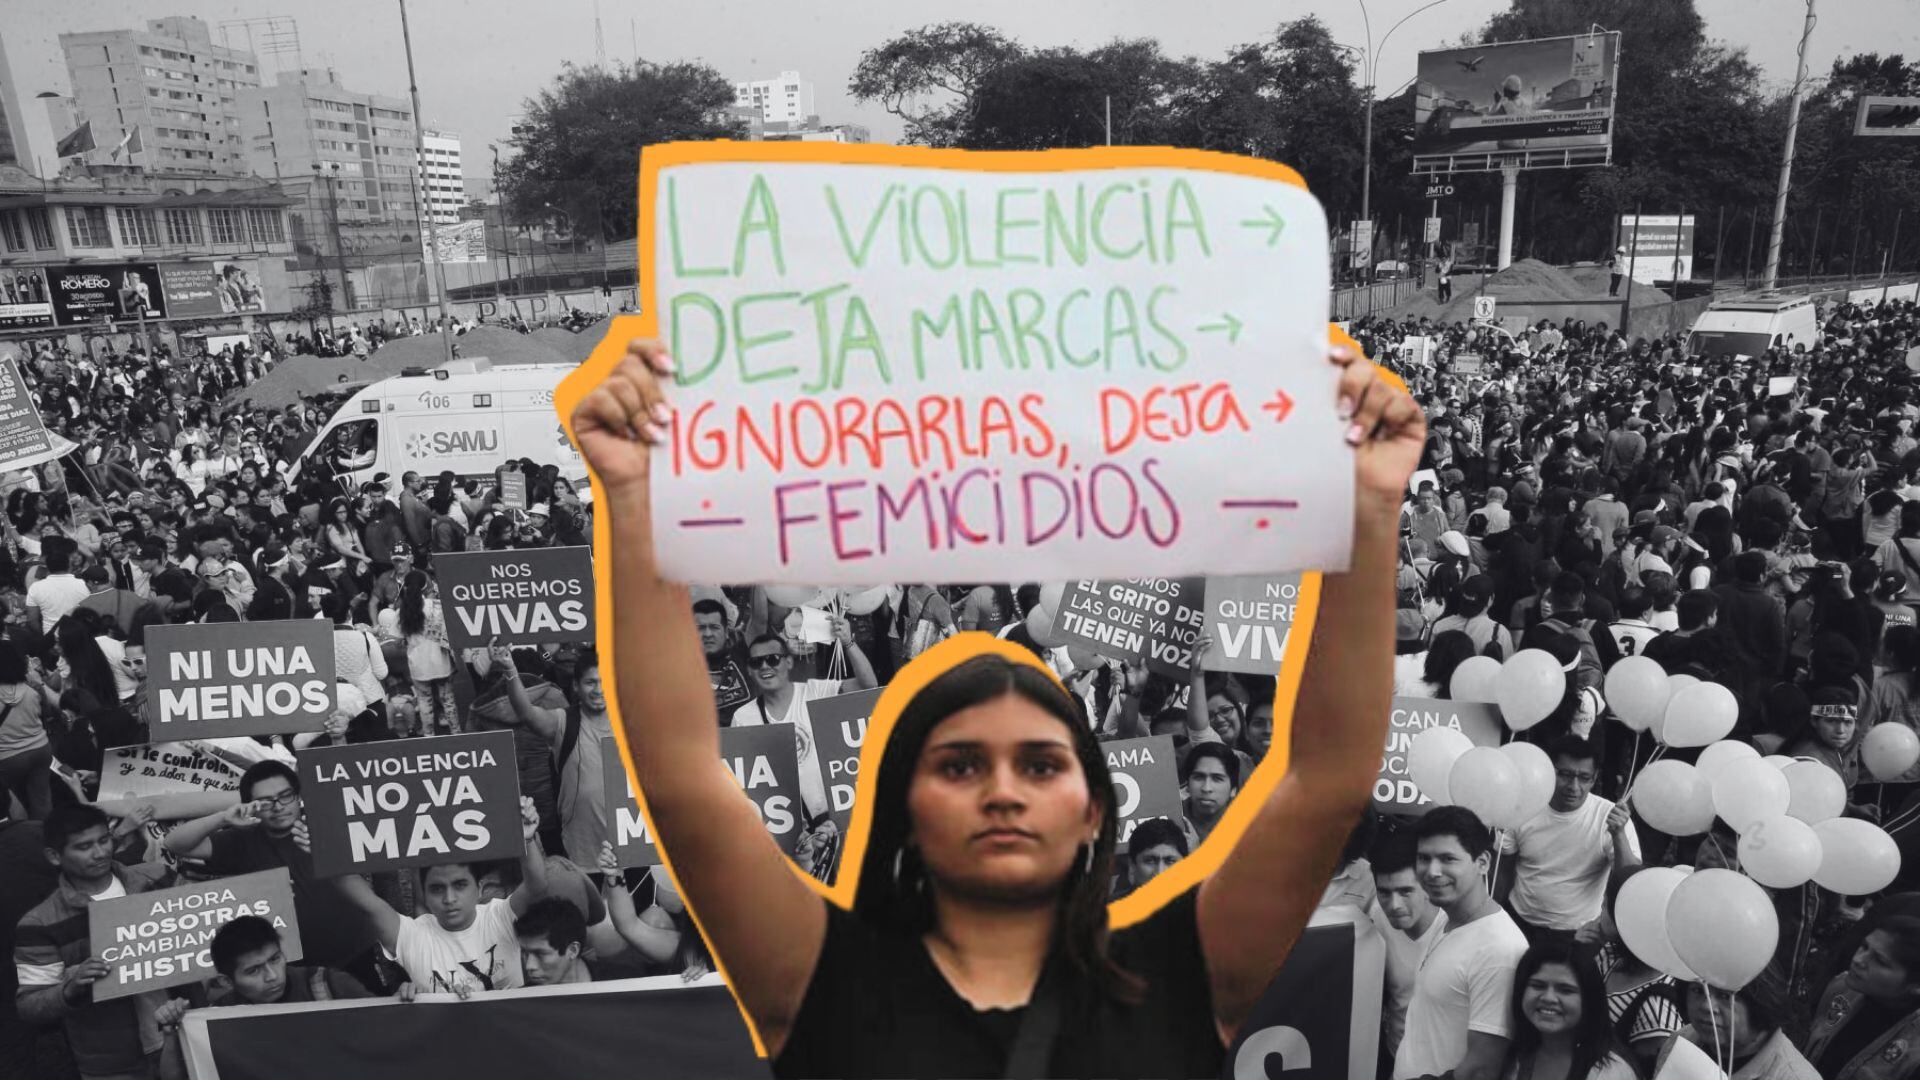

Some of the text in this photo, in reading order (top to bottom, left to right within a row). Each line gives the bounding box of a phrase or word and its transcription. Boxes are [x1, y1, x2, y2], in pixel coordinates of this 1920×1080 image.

[1426, 186, 1443, 195] JMT
[667, 173, 786, 279] LA
[61, 278, 110, 290] ROMERO
[670, 283, 1188, 395] DEJA MARCAS
[427, 395, 450, 408] 106
[432, 430, 498, 453] SAMU
[490, 563, 532, 578] NOS
[452, 579, 582, 601] QUEREMOS
[1077, 577, 1204, 628] EL GRITO DE
[454, 600, 588, 637] VIVAS
[1070, 594, 1198, 645] LAS QUE YA NO
[1063, 611, 1193, 669] TIENEN VOZ
[1216, 622, 1291, 662] VIV
[170, 646, 317, 682] NI UNA
[159, 680, 330, 723] MENOS
[1390, 709, 1440, 730] CAN
[315, 749, 497, 783] LA VIOLENCIA
[1107, 747, 1156, 769] AMA
[119, 762, 241, 793] y es dolor lo que sien
[342, 775, 484, 816] NO VA
[347, 802, 491, 863] MÁS
[150, 888, 236, 916] AHORA
[116, 899, 271, 943] NOSOTRAS
[101, 928, 217, 962] CAMBIAM
[118, 947, 215, 985] HISTO
